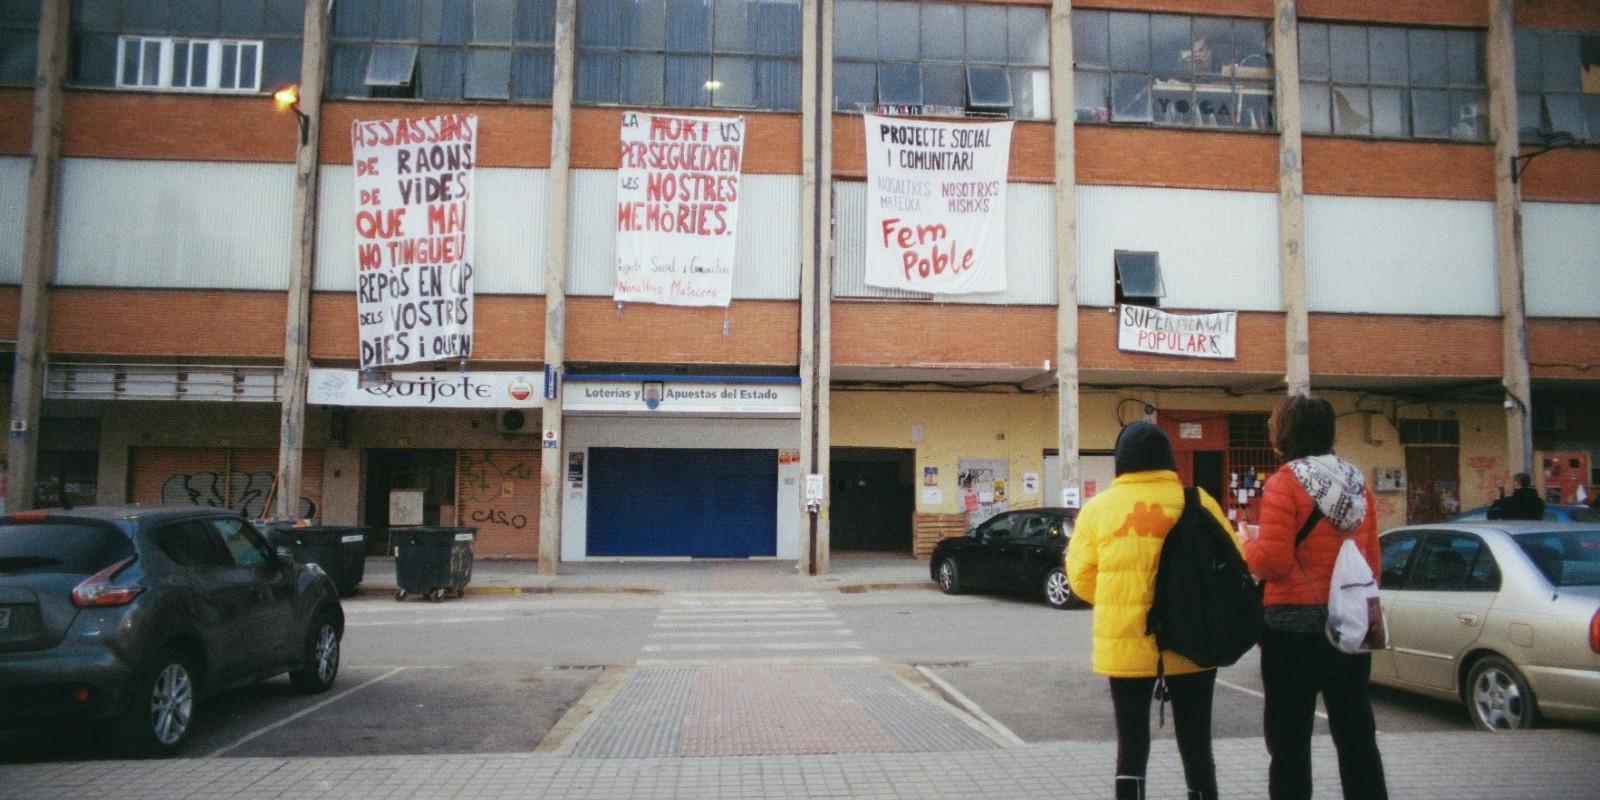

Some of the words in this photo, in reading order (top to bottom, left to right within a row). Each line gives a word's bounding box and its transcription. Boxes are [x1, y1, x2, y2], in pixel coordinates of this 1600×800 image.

[352, 112, 473, 148] ASSASSINS
[622, 113, 639, 129] LA
[649, 116, 708, 141] MORT
[719, 121, 740, 142] US
[880, 124, 945, 148] PROJECTE
[950, 128, 991, 149] SOCIAL
[357, 156, 379, 176] DE
[397, 143, 474, 174] RAONS
[619, 140, 739, 171] PERSEGUEIXEN
[899, 148, 974, 171] COMUNITARI
[360, 188, 381, 205] DE
[622, 176, 639, 190] LES
[647, 172, 737, 202] NOSTRES
[878, 175, 931, 197] NOSALTRES
[942, 180, 999, 198] NOSOTRXS
[355, 207, 406, 239] QUE
[427, 200, 466, 235] MAI
[948, 198, 990, 213] MISMXS
[881, 218, 946, 248] Fem
[358, 242, 381, 271] NO
[386, 233, 465, 268] TINGUEU
[902, 239, 974, 280] Poble
[359, 267, 410, 303] REPÒS
[419, 265, 442, 297] EN
[360, 310, 383, 326] DELS
[585, 388, 631, 398] Loterías
[634, 389, 641, 400] y
[666, 388, 717, 400] Apuestas
[720, 389, 737, 399] del
[739, 389, 778, 399] Estado
